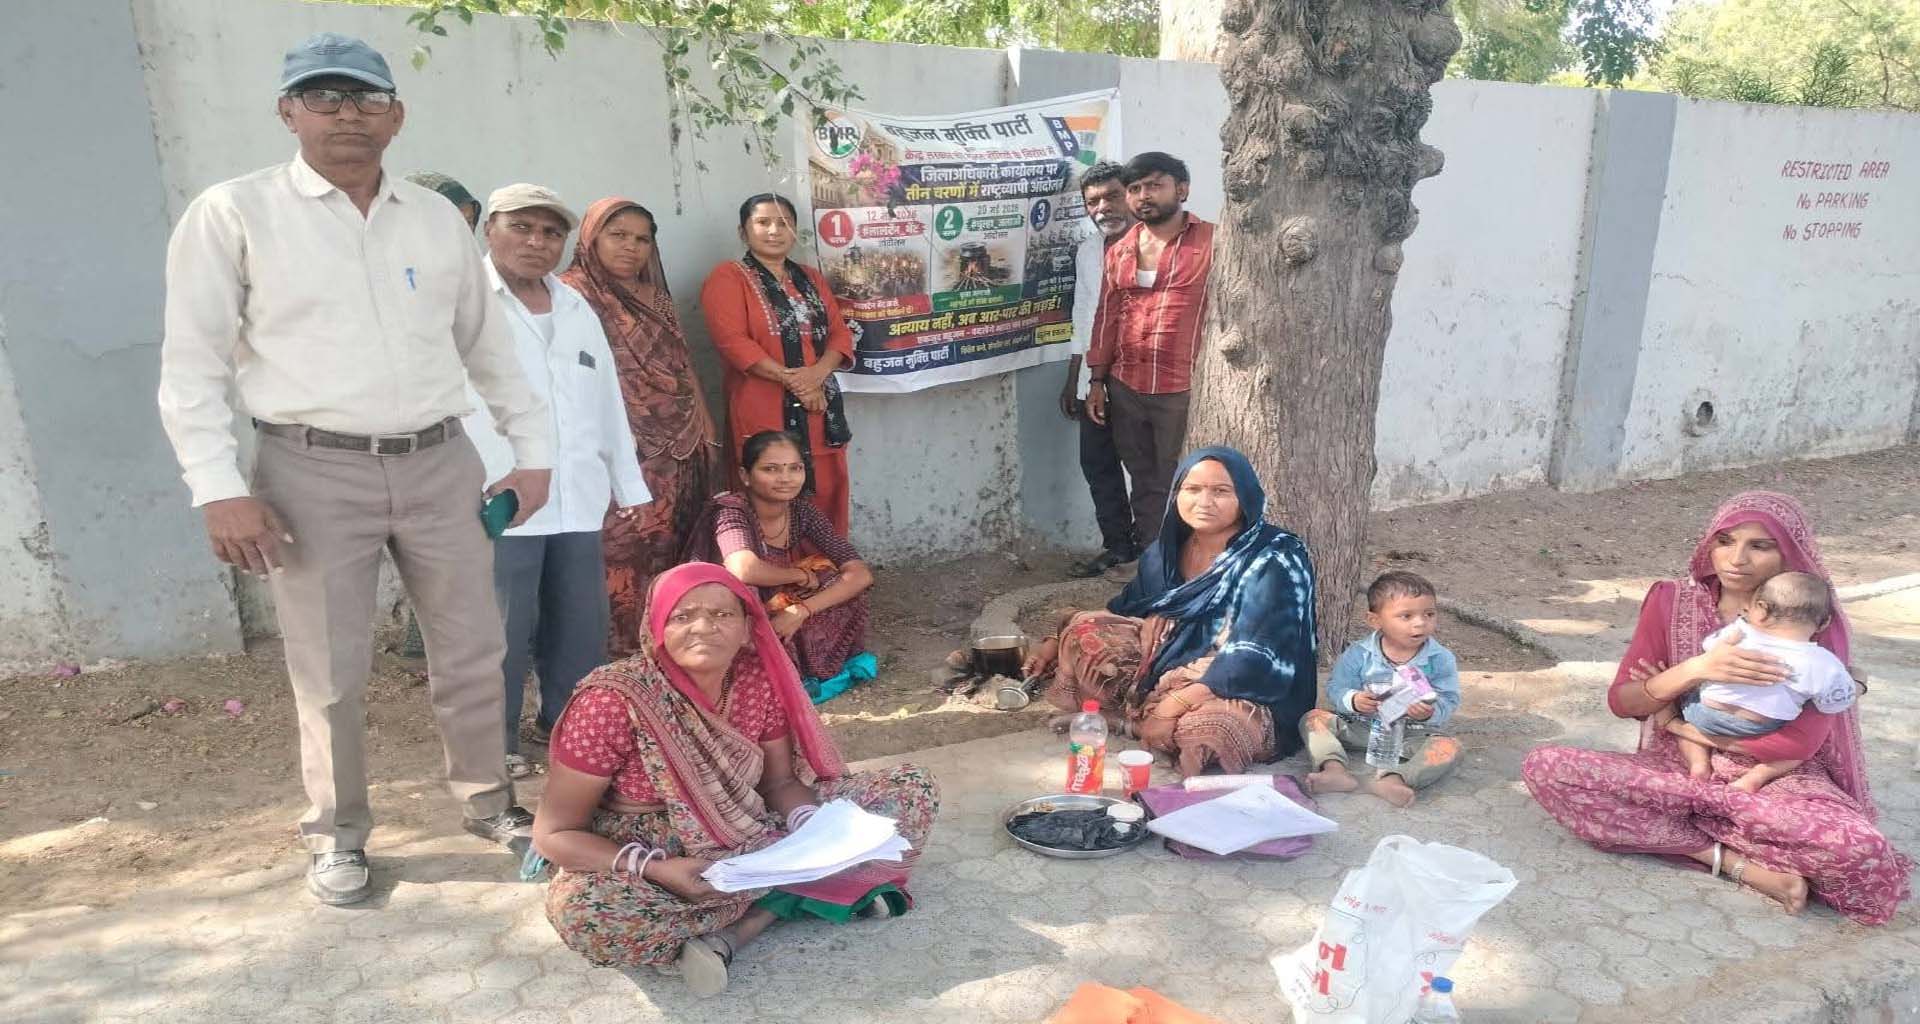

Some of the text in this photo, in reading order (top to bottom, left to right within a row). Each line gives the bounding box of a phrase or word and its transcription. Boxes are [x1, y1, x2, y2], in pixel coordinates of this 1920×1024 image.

[881, 113, 1033, 146] बहुजन मुक्ति पार्टी
[920, 162, 1058, 182] जिलाअधिकारी कार्यालय पर
[1781, 160, 1890, 180] RESTRICTED AREA
[905, 184, 931, 200] तीन
[932, 181, 966, 199] चरणों
[969, 181, 981, 198] में
[981, 178, 1028, 198] राष्ट्रव्यापी
[1796, 192, 1869, 209] No PARKING
[943, 209, 954, 230] 2
[1037, 202, 1046, 221] 3
[831, 214, 841, 236] 1
[1783, 222, 1862, 240] No STOPPING
[889, 320, 929, 336] अन्याय
[932, 312, 955, 329] नहीं,
[959, 312, 978, 326] अब
[979, 306, 1019, 323] आर-पार
[1020, 300, 1032, 316] की
[863, 345, 950, 373] बहुजन मुक्ति पार्टी
